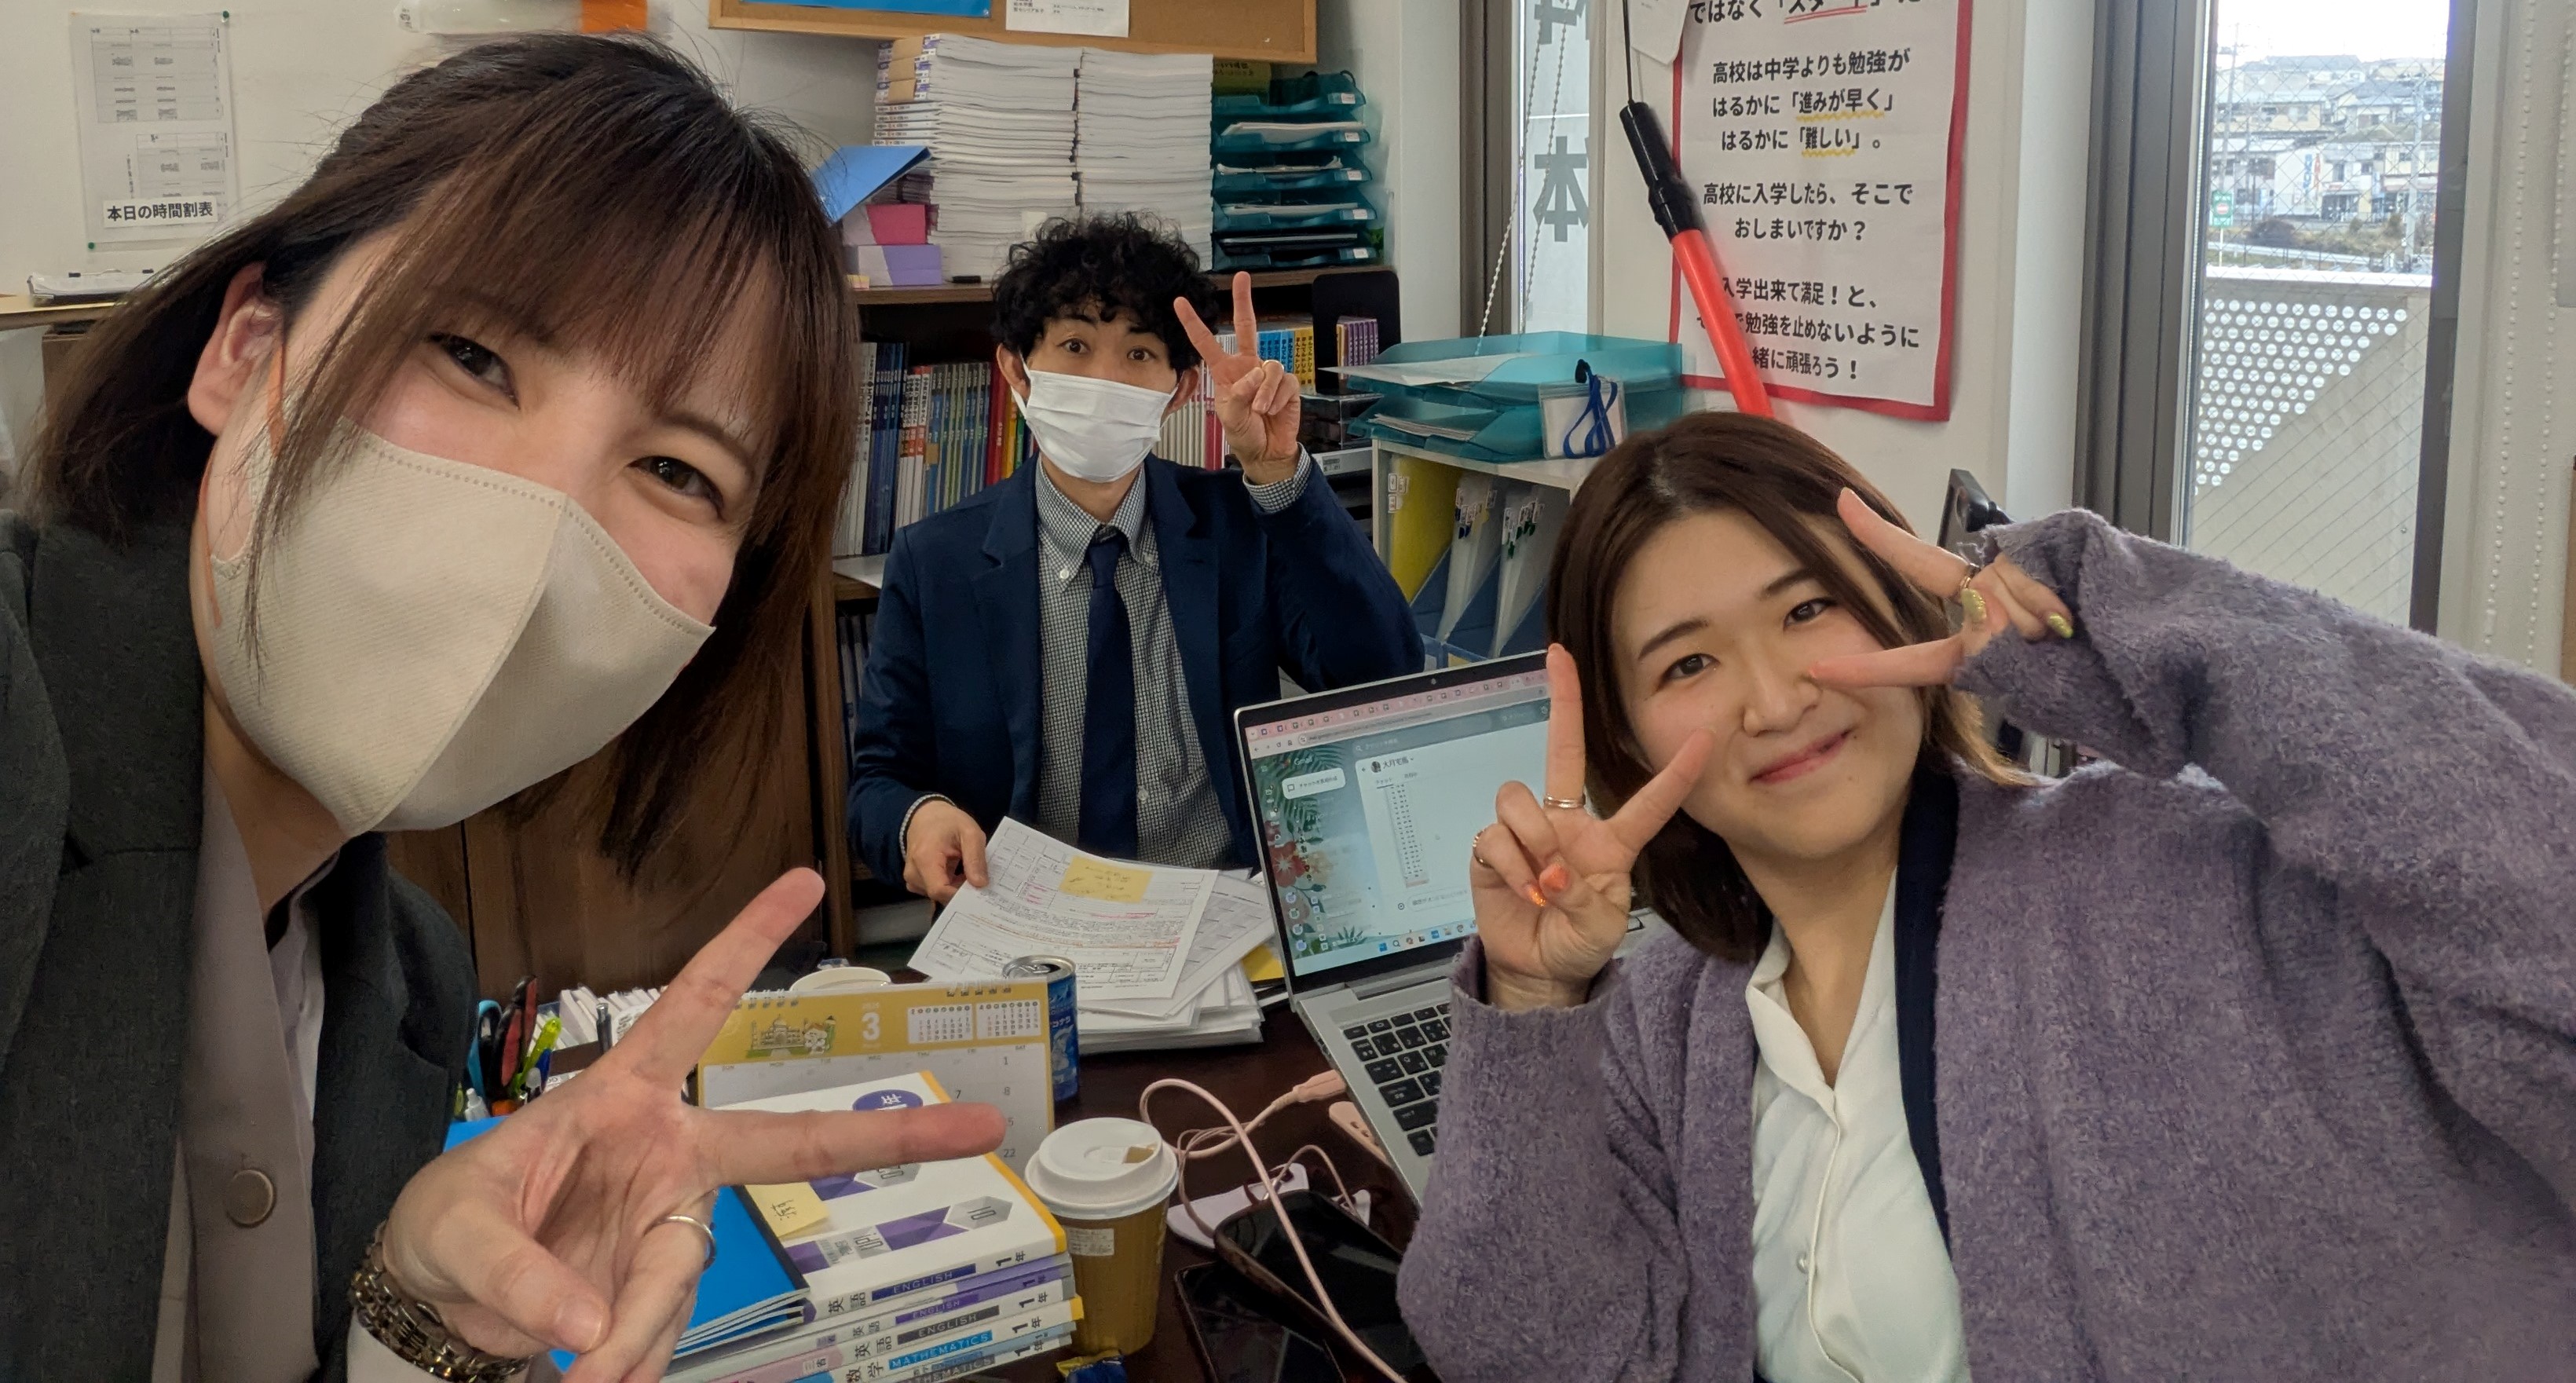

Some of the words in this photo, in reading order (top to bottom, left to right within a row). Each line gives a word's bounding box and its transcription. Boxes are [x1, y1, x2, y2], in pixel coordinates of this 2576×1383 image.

[1713, 48, 1911, 84] 高校は中学よりも勉強が
[1712, 87, 1894, 117] はるかに「進みが早く」
[1721, 126, 1882, 151] はるかに「難しい」。
[1703, 182, 1913, 206] 高校に入学したら、そこで
[108, 202, 213, 221] 本日の時間割表
[1734, 218, 1866, 241] おしまいですか？
[862, 1012, 880, 1041] 3
[1004, 1056, 1008, 1066] 1
[956, 1090, 962, 1099] 7
[1003, 1148, 1016, 1158] 22
[828, 1292, 866, 1315] 英語
[892, 1273, 953, 1293] ENGLISH
[996, 1250, 1026, 1267] 1年
[913, 1300, 960, 1319] ENGLISH
[854, 1336, 892, 1359] 英語
[918, 1314, 978, 1337] ENGLISH
[1019, 1292, 1048, 1308] 1年
[892, 1334, 990, 1368] MATHEMATICS
[1012, 1316, 1042, 1334] 1年
